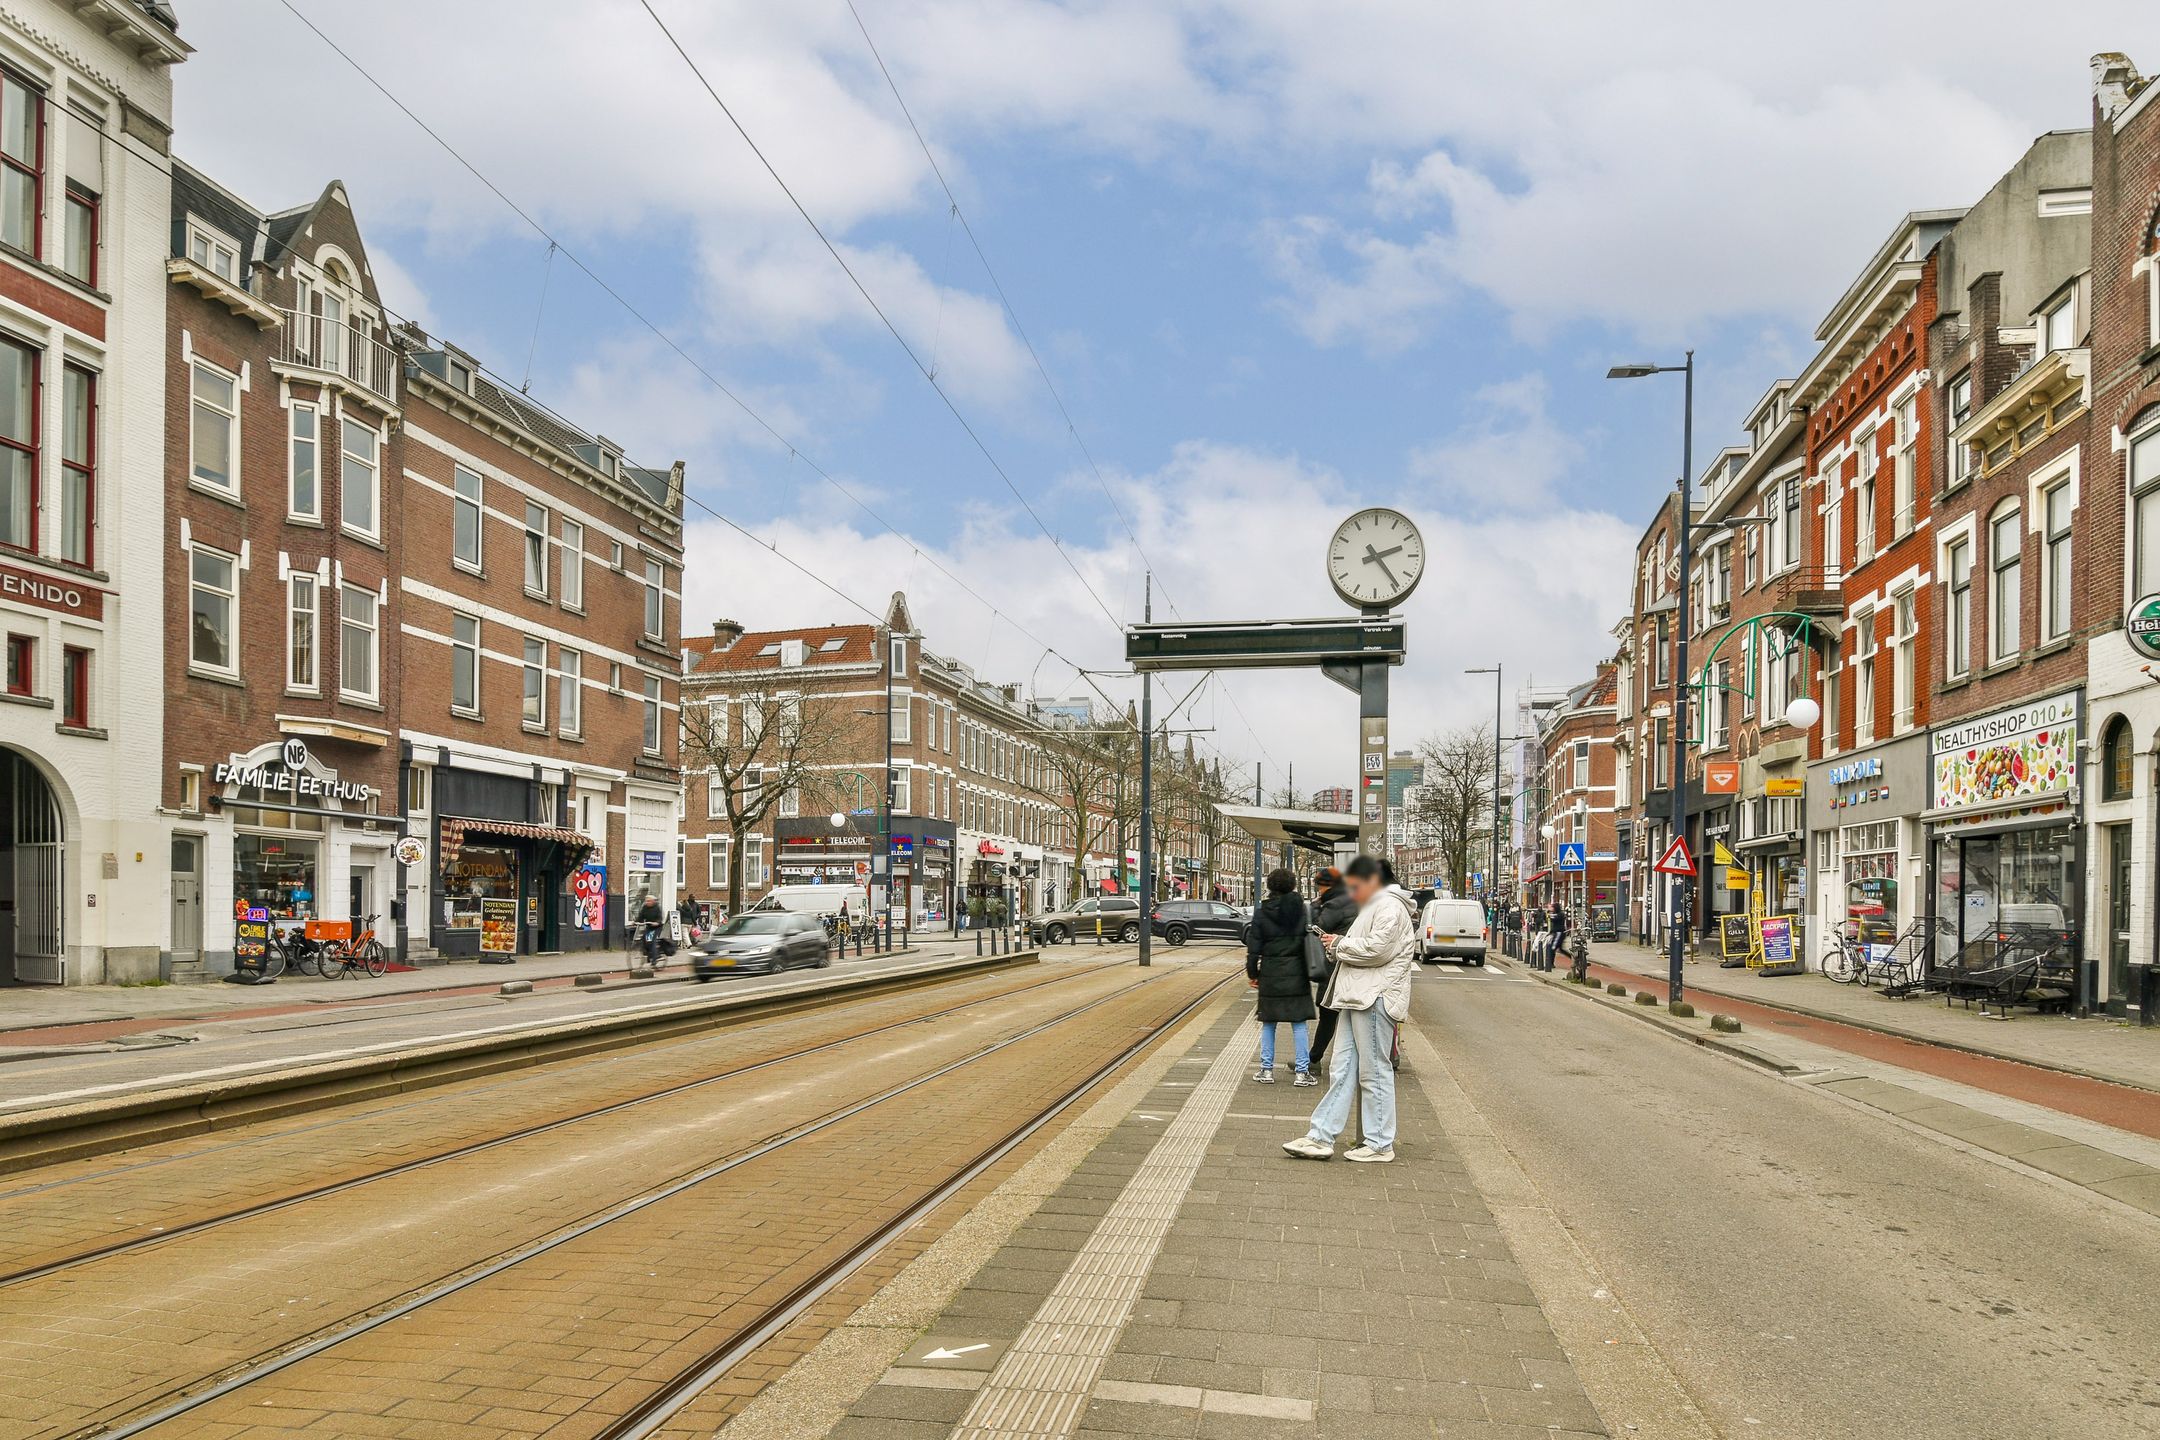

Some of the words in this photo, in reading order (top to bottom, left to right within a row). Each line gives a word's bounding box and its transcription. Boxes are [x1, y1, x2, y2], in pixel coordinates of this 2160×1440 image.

[0, 573, 81, 607] ENIDO
[2031, 705, 2056, 727] 010
[288, 745, 305, 764] NB
[215, 763, 290, 791] FAMILIE
[299, 776, 370, 801] EETHUIS
[831, 836, 866, 845] TELECOM
[454, 864, 508, 877] NOTENDAM
[1762, 922, 1789, 930] JACKPOT
